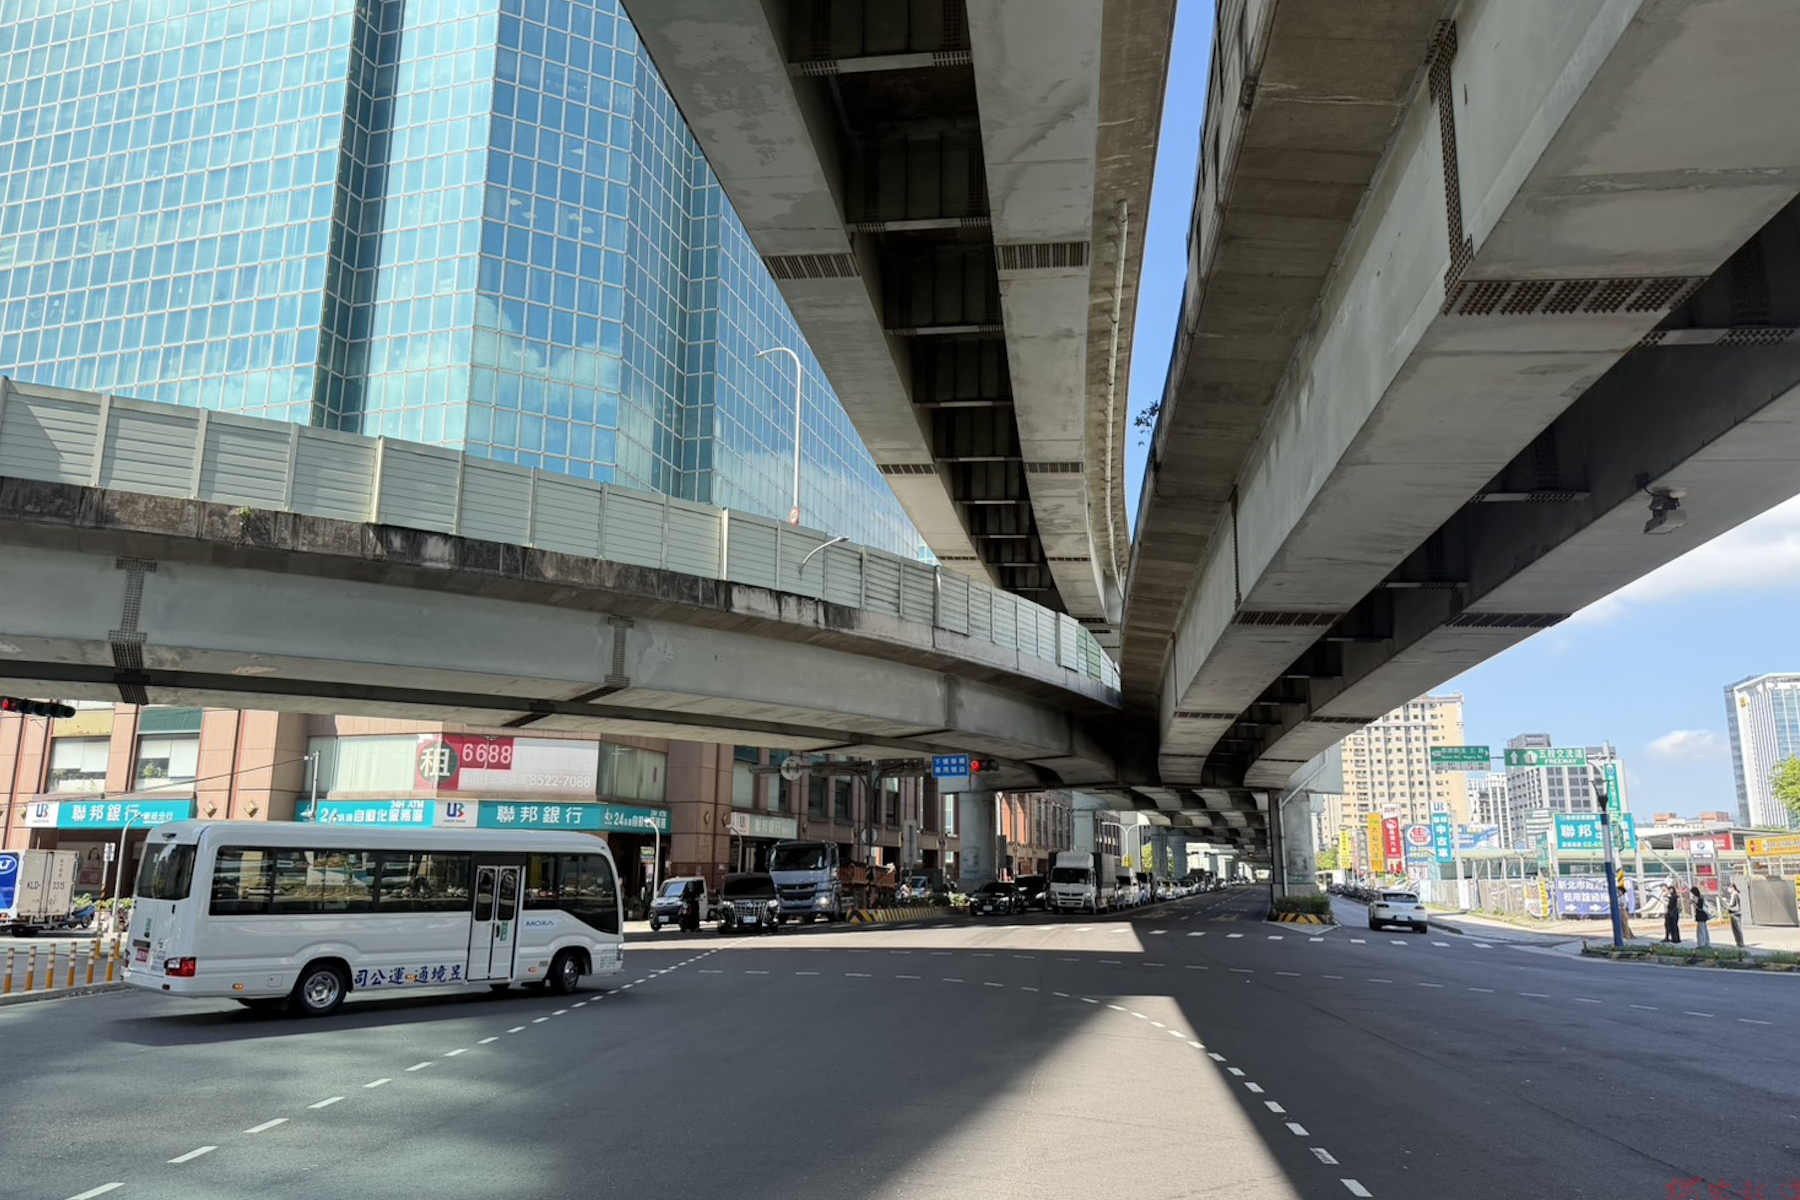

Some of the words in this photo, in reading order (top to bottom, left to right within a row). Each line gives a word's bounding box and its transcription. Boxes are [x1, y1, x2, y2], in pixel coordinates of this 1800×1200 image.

[419, 747, 450, 777] 租
[462, 743, 512, 764] 6688
[529, 774, 591, 789] 8522-7088
[71, 803, 140, 822] 聯邦銀行
[496, 805, 583, 824] 聯邦銀行
